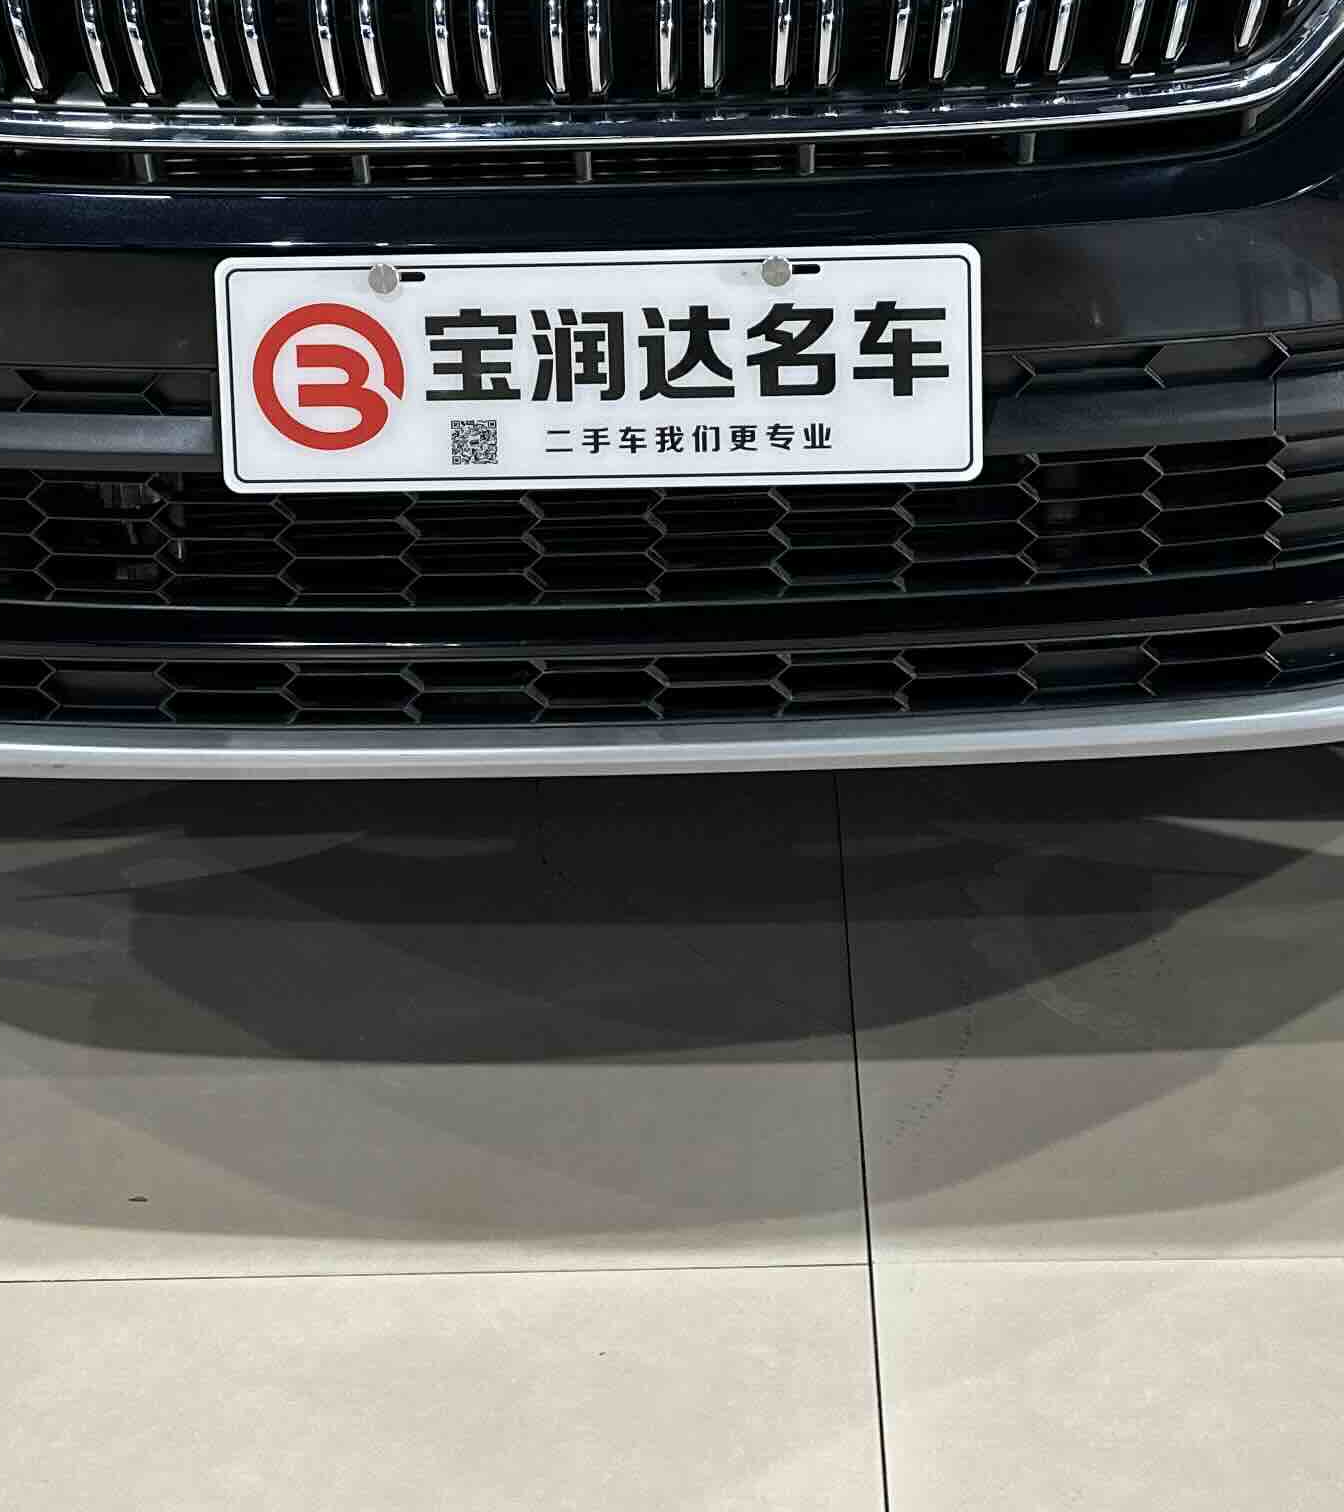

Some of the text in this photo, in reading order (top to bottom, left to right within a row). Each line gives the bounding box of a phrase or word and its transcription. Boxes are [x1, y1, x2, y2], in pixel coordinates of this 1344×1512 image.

[424, 300, 951, 402] 宝润达名车
[545, 422, 833, 455] 二手车我们更专业
